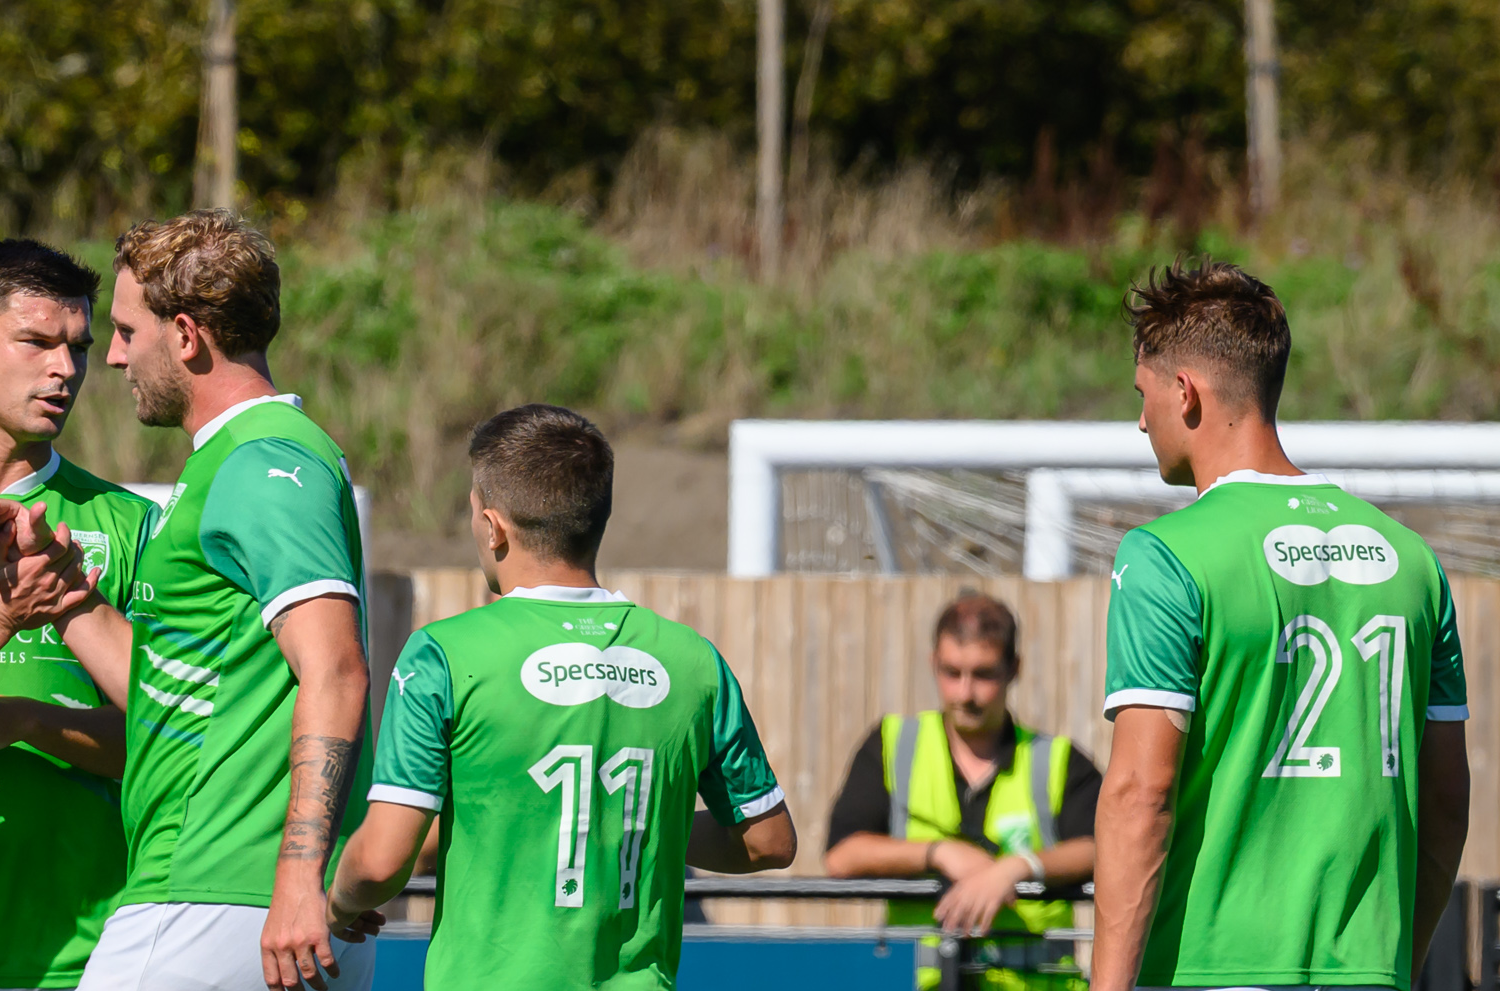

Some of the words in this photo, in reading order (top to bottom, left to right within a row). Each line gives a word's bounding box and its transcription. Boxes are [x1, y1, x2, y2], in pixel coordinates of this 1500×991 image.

[73, 531, 106, 541] UERNSEY
[1274, 541, 1386, 567] Specsavers
[537, 661, 658, 688] Specsavers
[1261, 614, 1406, 778] 21
[528, 744, 654, 909] 11
